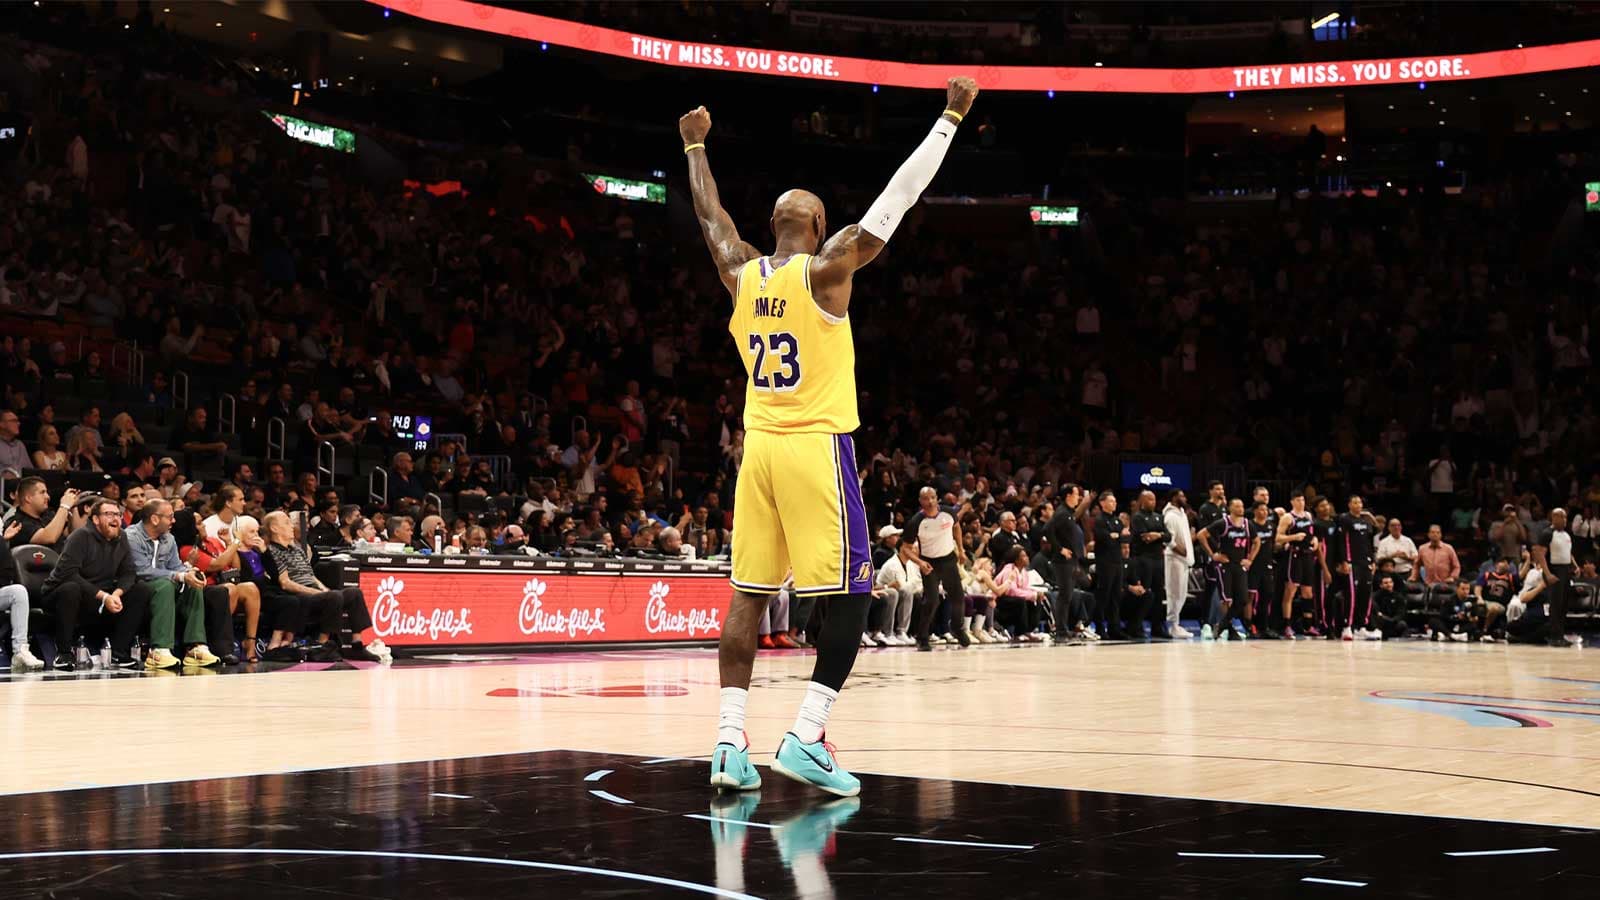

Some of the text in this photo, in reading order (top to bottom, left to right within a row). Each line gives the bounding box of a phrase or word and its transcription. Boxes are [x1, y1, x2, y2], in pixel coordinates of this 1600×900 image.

[631, 37, 840, 77] THEY MISS. YOU SCORE.
[1233, 58, 1471, 87] THEY MISS. YOU SCORE.
[752, 296, 787, 319] AMES
[748, 331, 802, 392] 23
